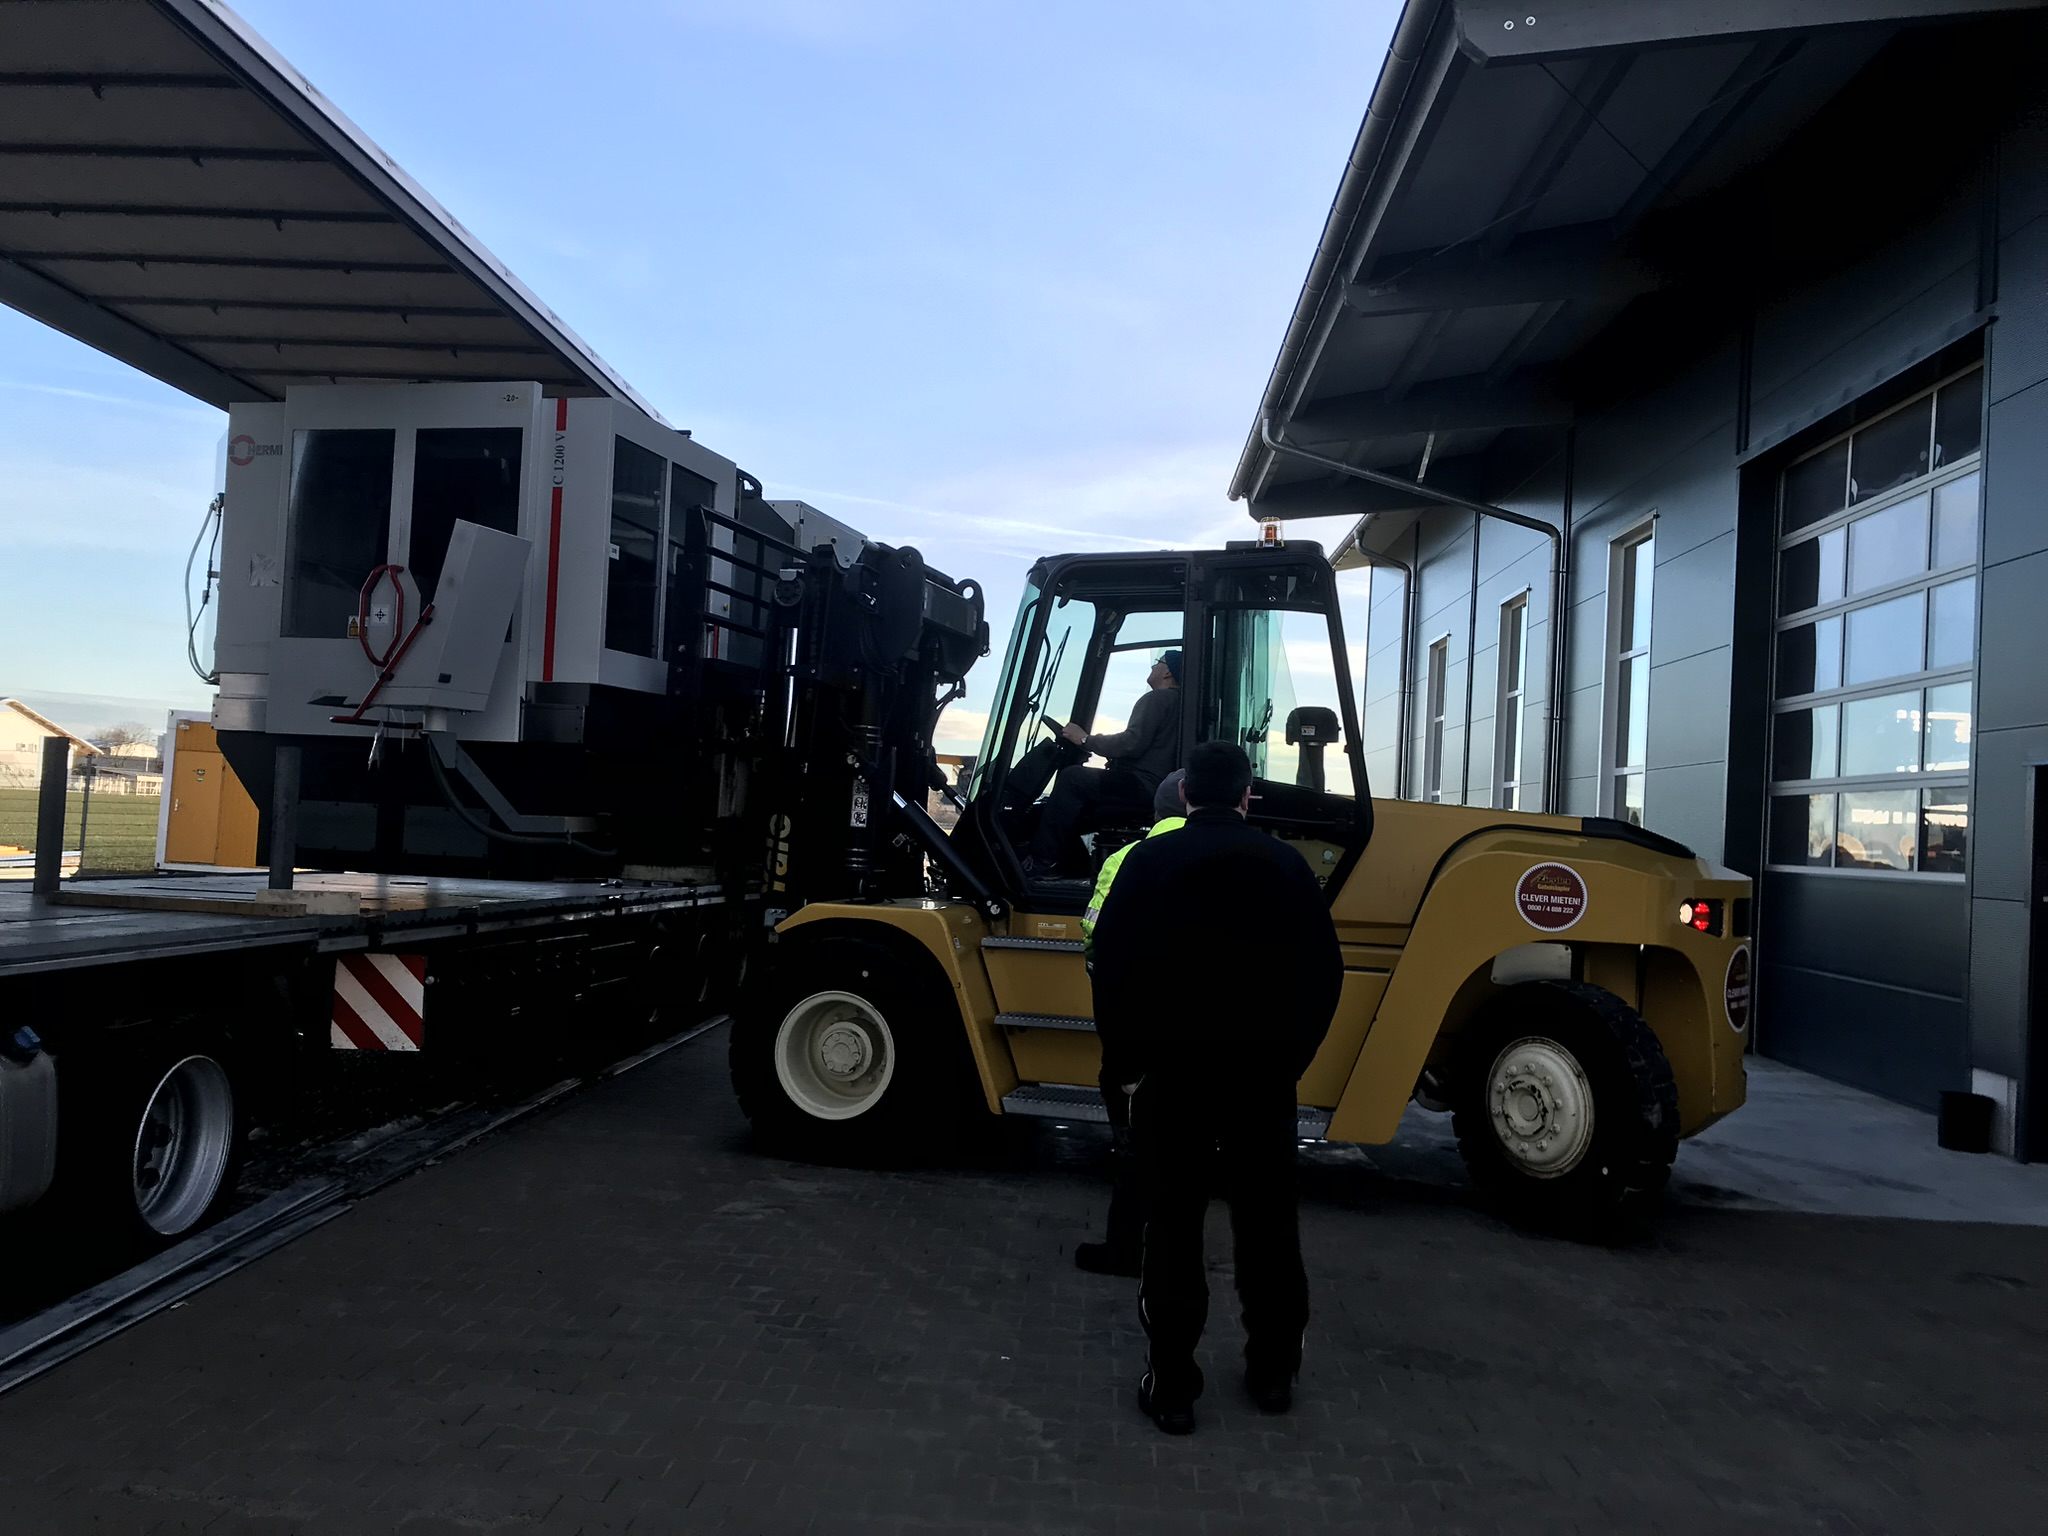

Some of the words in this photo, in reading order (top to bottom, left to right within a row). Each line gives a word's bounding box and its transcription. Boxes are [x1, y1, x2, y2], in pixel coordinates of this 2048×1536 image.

[555, 432, 566, 442] V
[554, 445, 566, 471] 1200
[552, 475, 565, 485] C
[1521, 893, 1549, 903] CLEVER
[1550, 895, 1581, 906] MIETEN!
